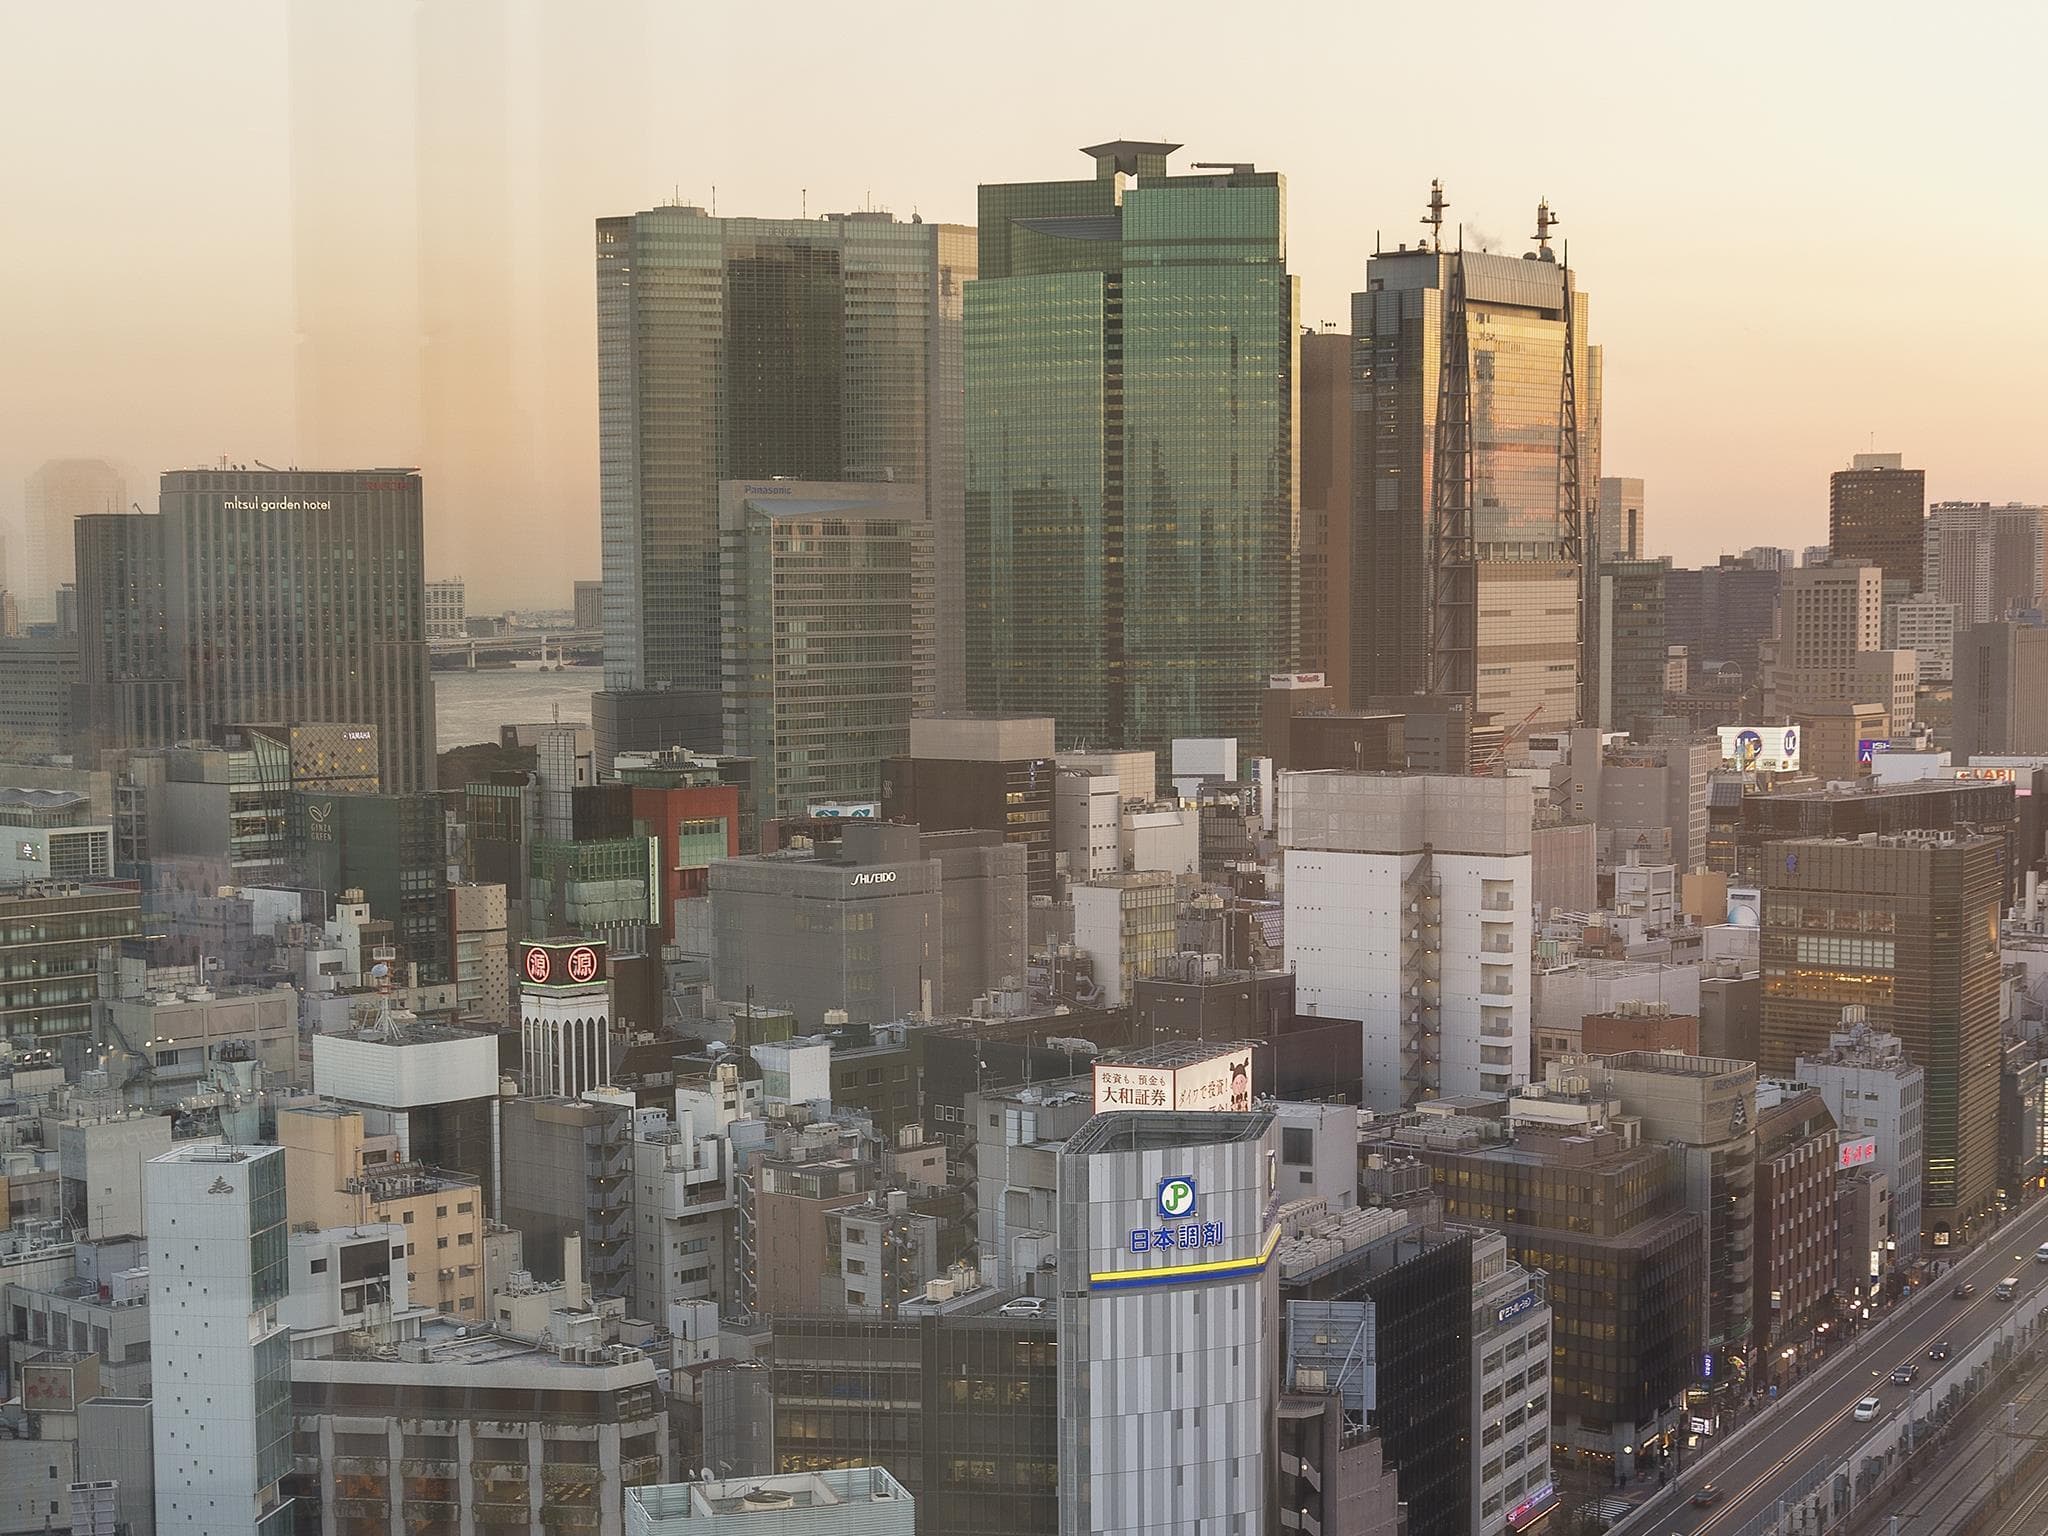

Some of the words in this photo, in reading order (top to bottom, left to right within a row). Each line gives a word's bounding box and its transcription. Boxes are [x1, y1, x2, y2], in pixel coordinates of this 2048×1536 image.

[744, 485, 792, 495] Panasonic
[224, 495, 258, 510] mitsui
[261, 495, 300, 512] garden
[303, 500, 330, 510] hotel
[348, 731, 371, 740] YAMAHA
[311, 823, 332, 832] GINZA
[311, 832, 332, 841] GREEN
[850, 871, 896, 886] SHISEIDO
[530, 953, 546, 977] 源
[573, 953, 592, 977] 源
[1102, 1072, 1166, 1087] 投資も、預金も
[1102, 1087, 1167, 1107] 大和証券
[1131, 1221, 1224, 1253] 日本調剤
